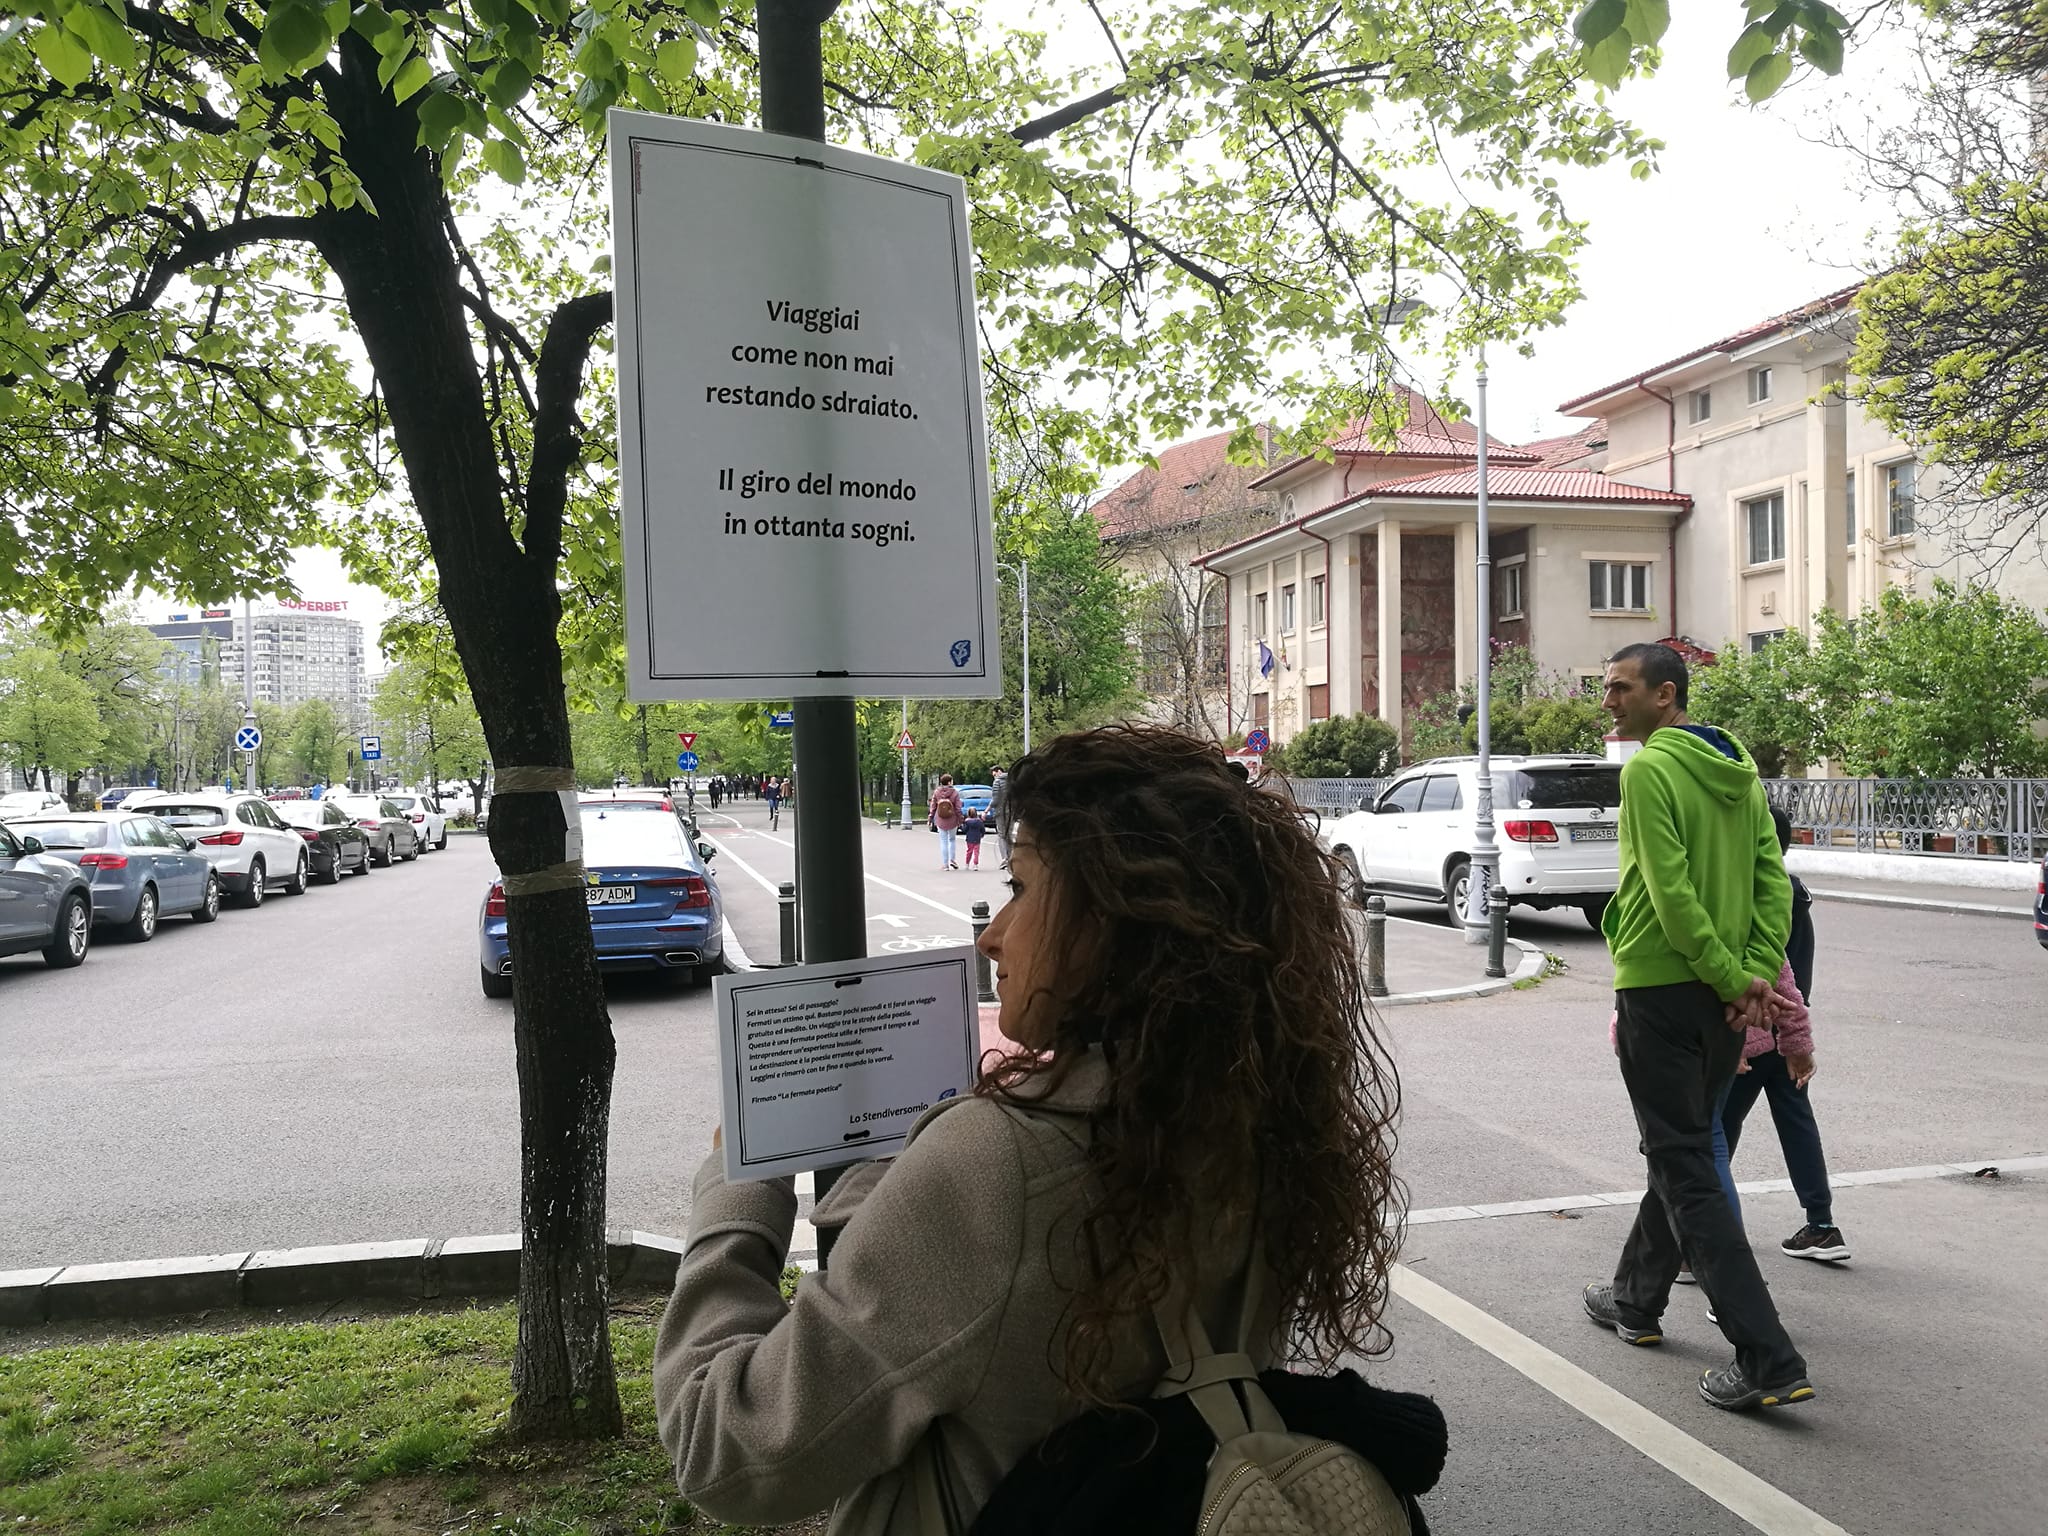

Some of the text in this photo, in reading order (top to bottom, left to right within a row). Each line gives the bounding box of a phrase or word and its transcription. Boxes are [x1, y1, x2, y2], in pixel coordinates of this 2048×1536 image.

[766, 300, 860, 334] Viaggiai
[731, 345, 894, 377] come non mai
[706, 385, 918, 420] restando sdraiato.
[719, 468, 916, 501] Il giro del mondo
[724, 512, 915, 548] in ottanta sogni.
[278, 598, 349, 612] SUPERBET
[1575, 830, 1587, 839] BH
[608, 888, 632, 899] ADM
[746, 1009, 756, 1017] Sei
[757, 1008, 763, 1016] in
[788, 1004, 797, 1012] Sei
[747, 1018, 772, 1029] Fermati
[843, 1007, 859, 1016] pochi
[861, 1003, 882, 1012] secondi
[893, 1000, 906, 1009] farai
[916, 996, 936, 1005] viaggio
[748, 1030, 774, 1040] gratuito
[775, 1026, 783, 1035] ed
[819, 1021, 840, 1029] viaggio
[859, 1015, 876, 1023] strofe
[877, 1013, 891, 1021] della
[748, 1041, 771, 1052] Questa
[790, 1035, 815, 1045] fermata
[816, 1032, 838, 1042] poetica
[859, 1026, 882, 1035] fermare
[749, 1049, 792, 1060] intraprendere
[750, 1063, 758, 1071] La
[759, 1058, 798, 1070] destinazione
[811, 1053, 831, 1064] poesia
[832, 1051, 854, 1059] errante
[855, 1048, 864, 1057] qui
[751, 1071, 776, 1083] Leggimi
[826, 1064, 838, 1072] fino
[845, 1059, 866, 1069] quando
[752, 1095, 776, 1104] Firmato
[790, 1089, 815, 1099] fermata
[850, 1102, 930, 1126] Lo Stendiversomio
